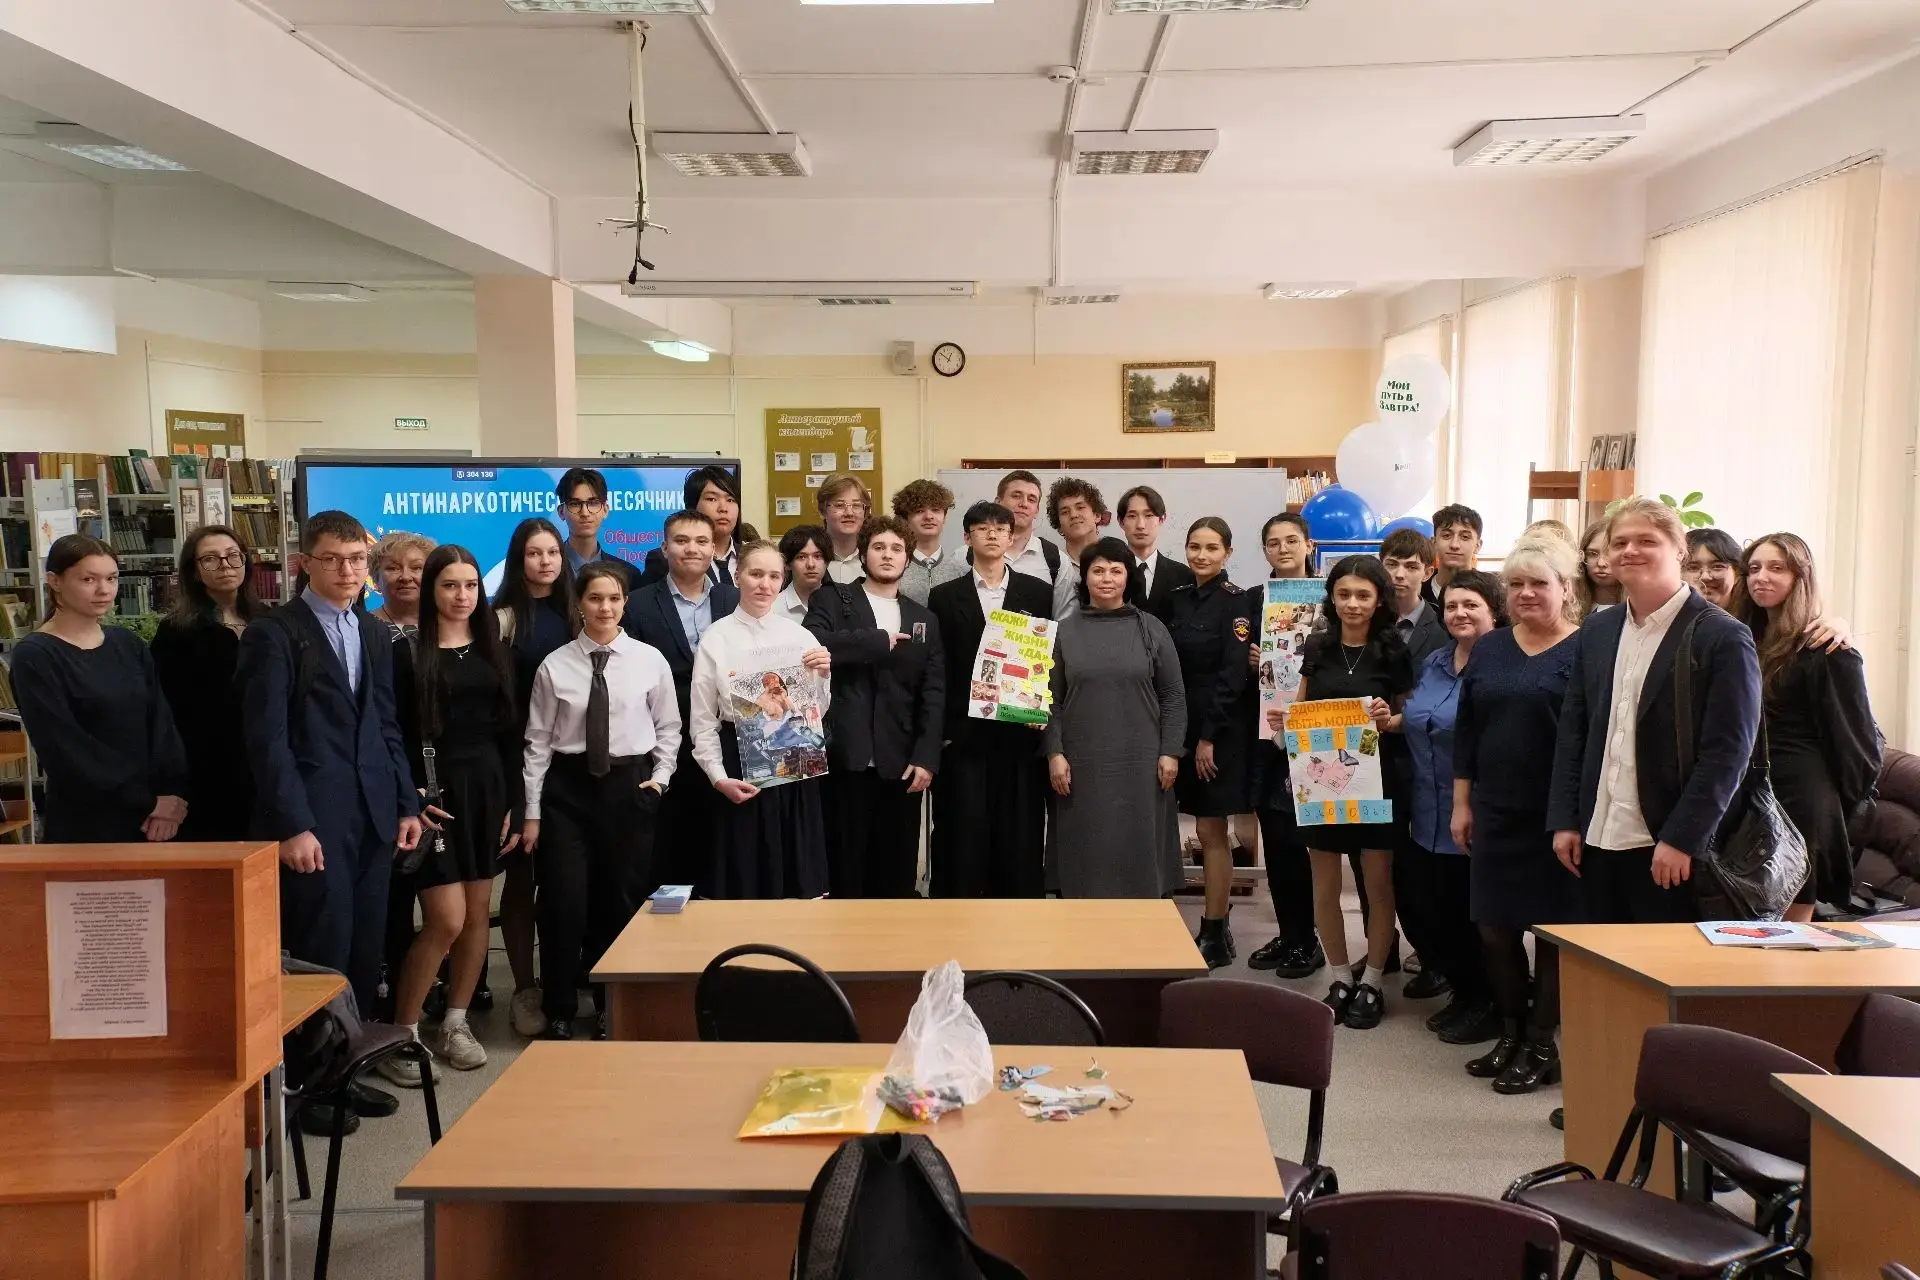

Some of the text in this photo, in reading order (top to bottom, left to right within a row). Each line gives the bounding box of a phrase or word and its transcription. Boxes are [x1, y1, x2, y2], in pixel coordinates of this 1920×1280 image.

[396, 419, 426, 427] ВЫХОД
[383, 491, 559, 514] АНТИНАРКОТИЧЕС
[604, 529, 664, 545] Общест
[1292, 580, 1326, 591] БУДУЩ
[989, 610, 1029, 627] СКАЖИ
[1004, 629, 1050, 649] ЖИЗНИ
[1290, 700, 1363, 716] ЗДОРОВЫМ
[1287, 715, 1370, 730] БЫТЬ МОДНО
